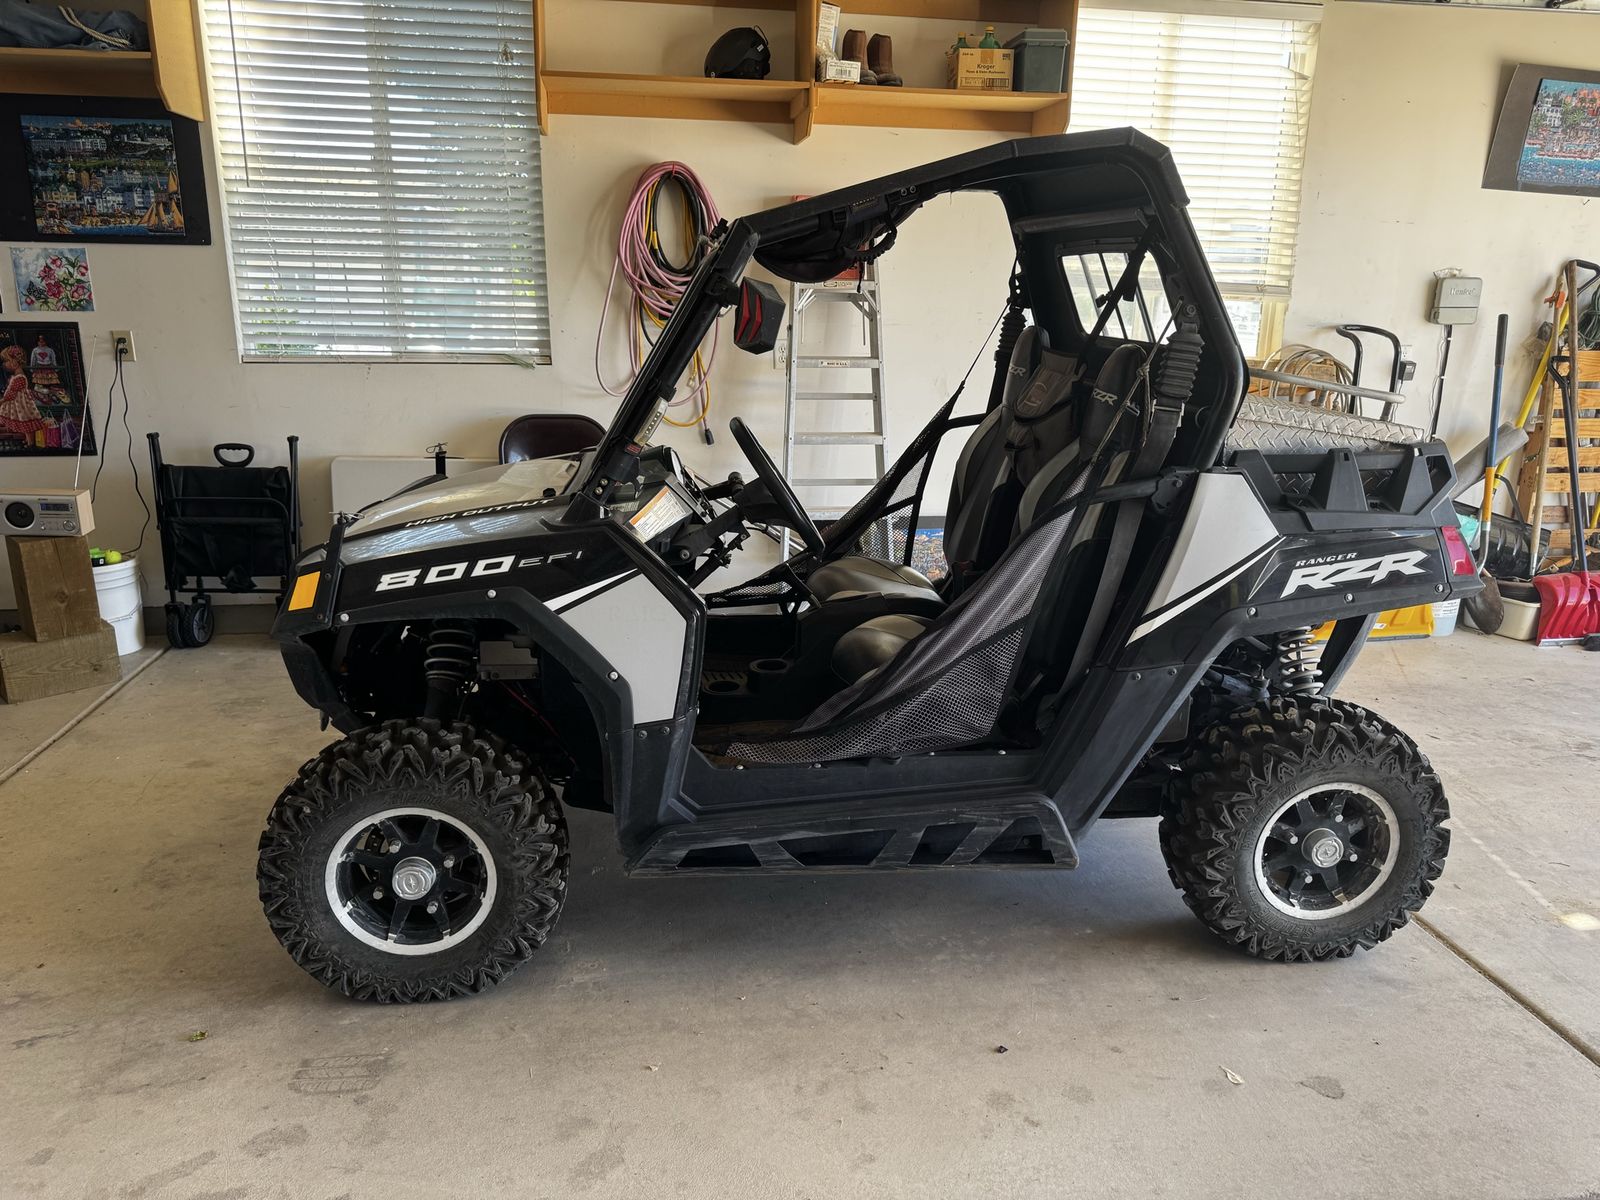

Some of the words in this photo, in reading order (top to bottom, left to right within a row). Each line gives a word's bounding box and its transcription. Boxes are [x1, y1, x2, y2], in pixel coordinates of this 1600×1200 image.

[976, 63, 996, 71] Kroger
[405, 513, 457, 527] HIGH
[462, 498, 555, 517] OUTPUT
[375, 555, 516, 592] 800
[518, 550, 583, 568] EFI
[1295, 552, 1358, 567] RANGER
[1280, 550, 1430, 599] RZR
